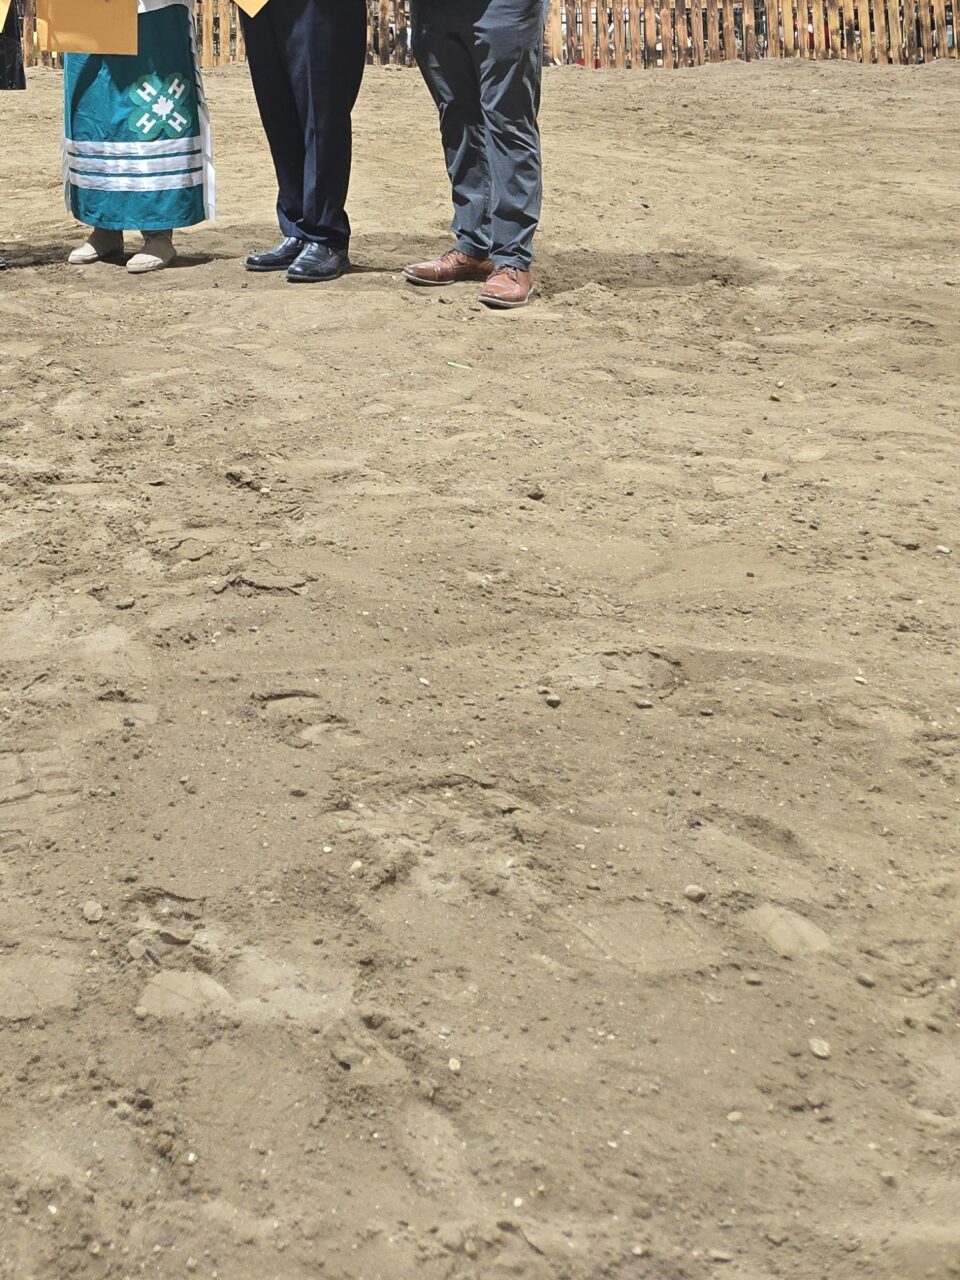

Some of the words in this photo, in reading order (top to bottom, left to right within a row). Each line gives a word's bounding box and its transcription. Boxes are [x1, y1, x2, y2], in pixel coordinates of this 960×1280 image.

[136, 82, 157, 102] H
[168, 78, 185, 99] H
[136, 113, 157, 134] H
[168, 111, 187, 133] H
